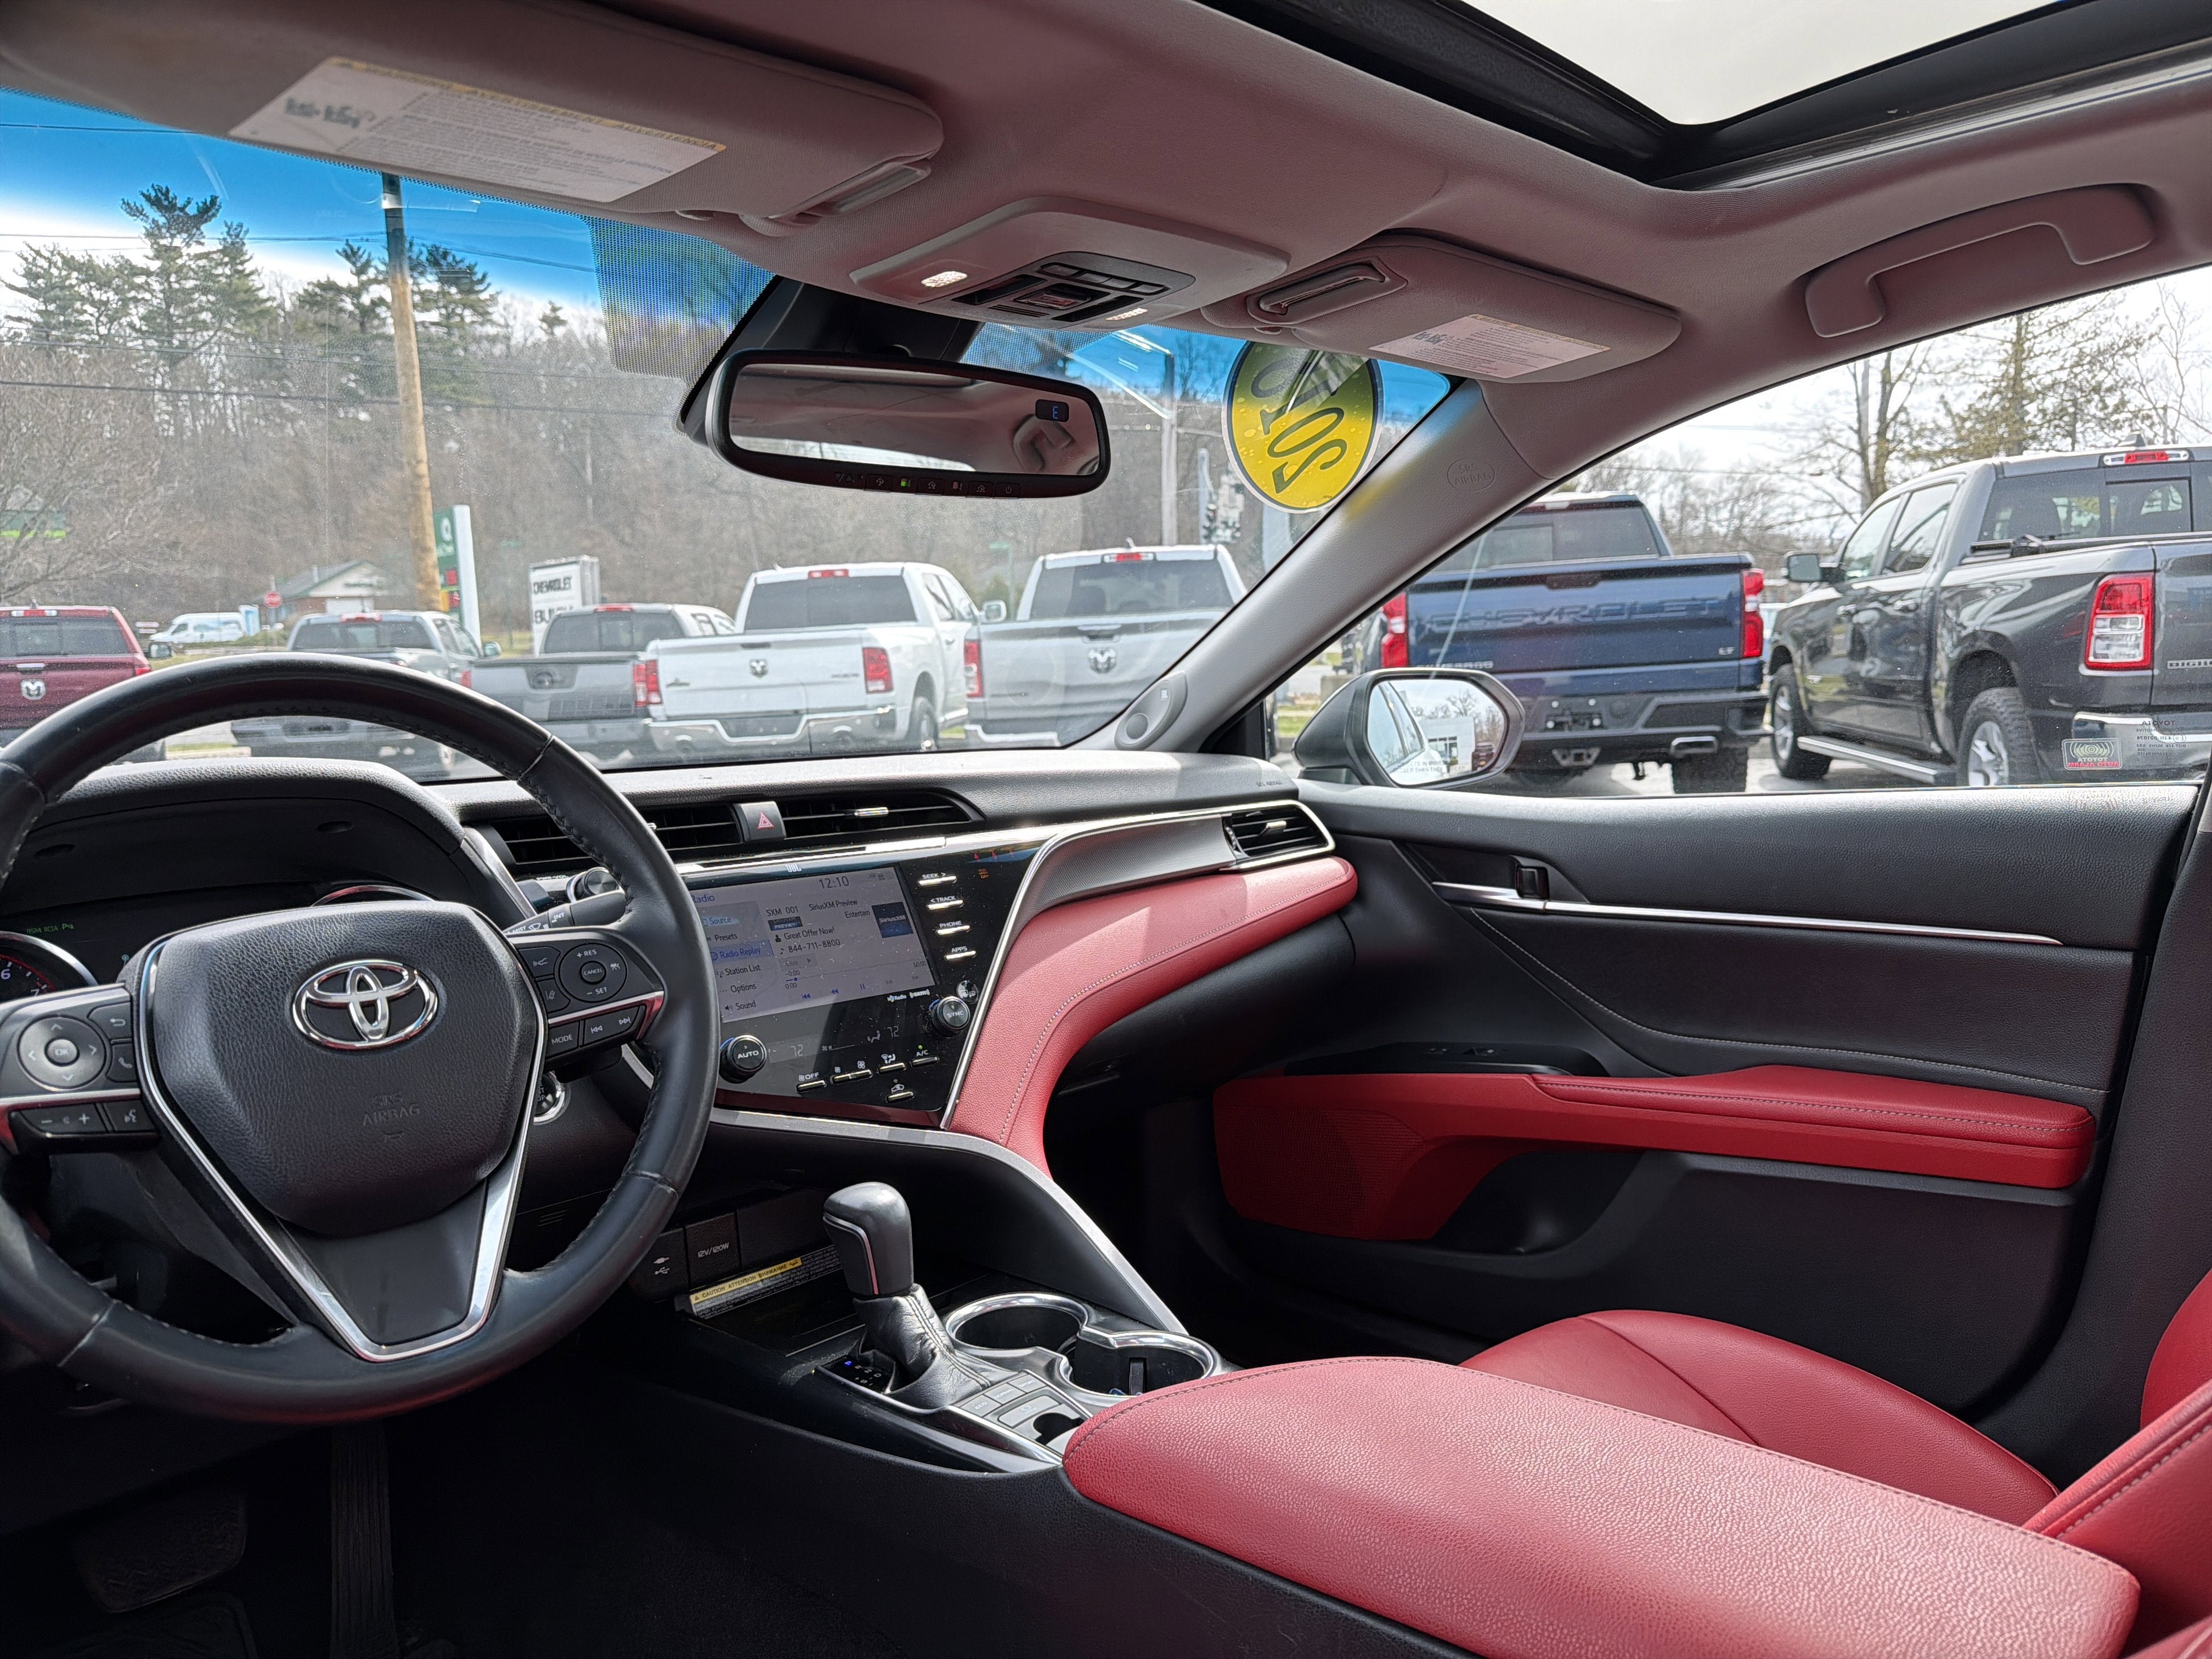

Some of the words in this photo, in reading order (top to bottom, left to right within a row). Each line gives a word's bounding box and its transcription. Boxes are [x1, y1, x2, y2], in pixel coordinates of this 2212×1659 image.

[1052, 405, 1059, 420] E
[1455, 472, 1491, 486] AIRBAG
[1429, 597, 1720, 633] CHEVROLET
[785, 864, 802, 873] JBL
[819, 876, 849, 889] 12:10
[692, 894, 715, 904] Radio
[766, 908, 782, 917] SXM
[786, 906, 799, 915] 001
[808, 901, 834, 911] SiriusXM
[844, 909, 871, 919] Entertain
[878, 914, 906, 924] SiriusXM
[709, 917, 731, 925] Source
[714, 933, 738, 942] Presets
[783, 932, 802, 940] Great
[802, 929, 818, 938] Offer
[819, 926, 835, 935] Now!
[788, 938, 841, 953] 844-711-8800
[583, 949, 597, 957] RES
[719, 950, 739, 959] Radio
[740, 947, 761, 957] Replay
[1, 968, 11, 980] 6
[583, 968, 603, 976] CANCEL
[725, 967, 748, 976] Station
[748, 964, 761, 973] List
[595, 986, 608, 995] SET
[730, 983, 757, 994] Options
[735, 1000, 757, 1011] Sound
[946, 1010, 964, 1018] SYNC
[887, 1024, 900, 1038] 72
[551, 1034, 573, 1045] MODE
[737, 1050, 759, 1059] AUTO
[790, 1044, 803, 1057] 72
[805, 1071, 820, 1080] OFF
[363, 1102, 420, 1126] AIRBAG
[697, 1242, 730, 1258] 12V/120W
[758, 1263, 787, 1279] ВНИМАНИЕ
[702, 1285, 726, 1299] CAUTION
[728, 1275, 757, 1289] ATTENTION
[974, 1401, 988, 1410] ECO
